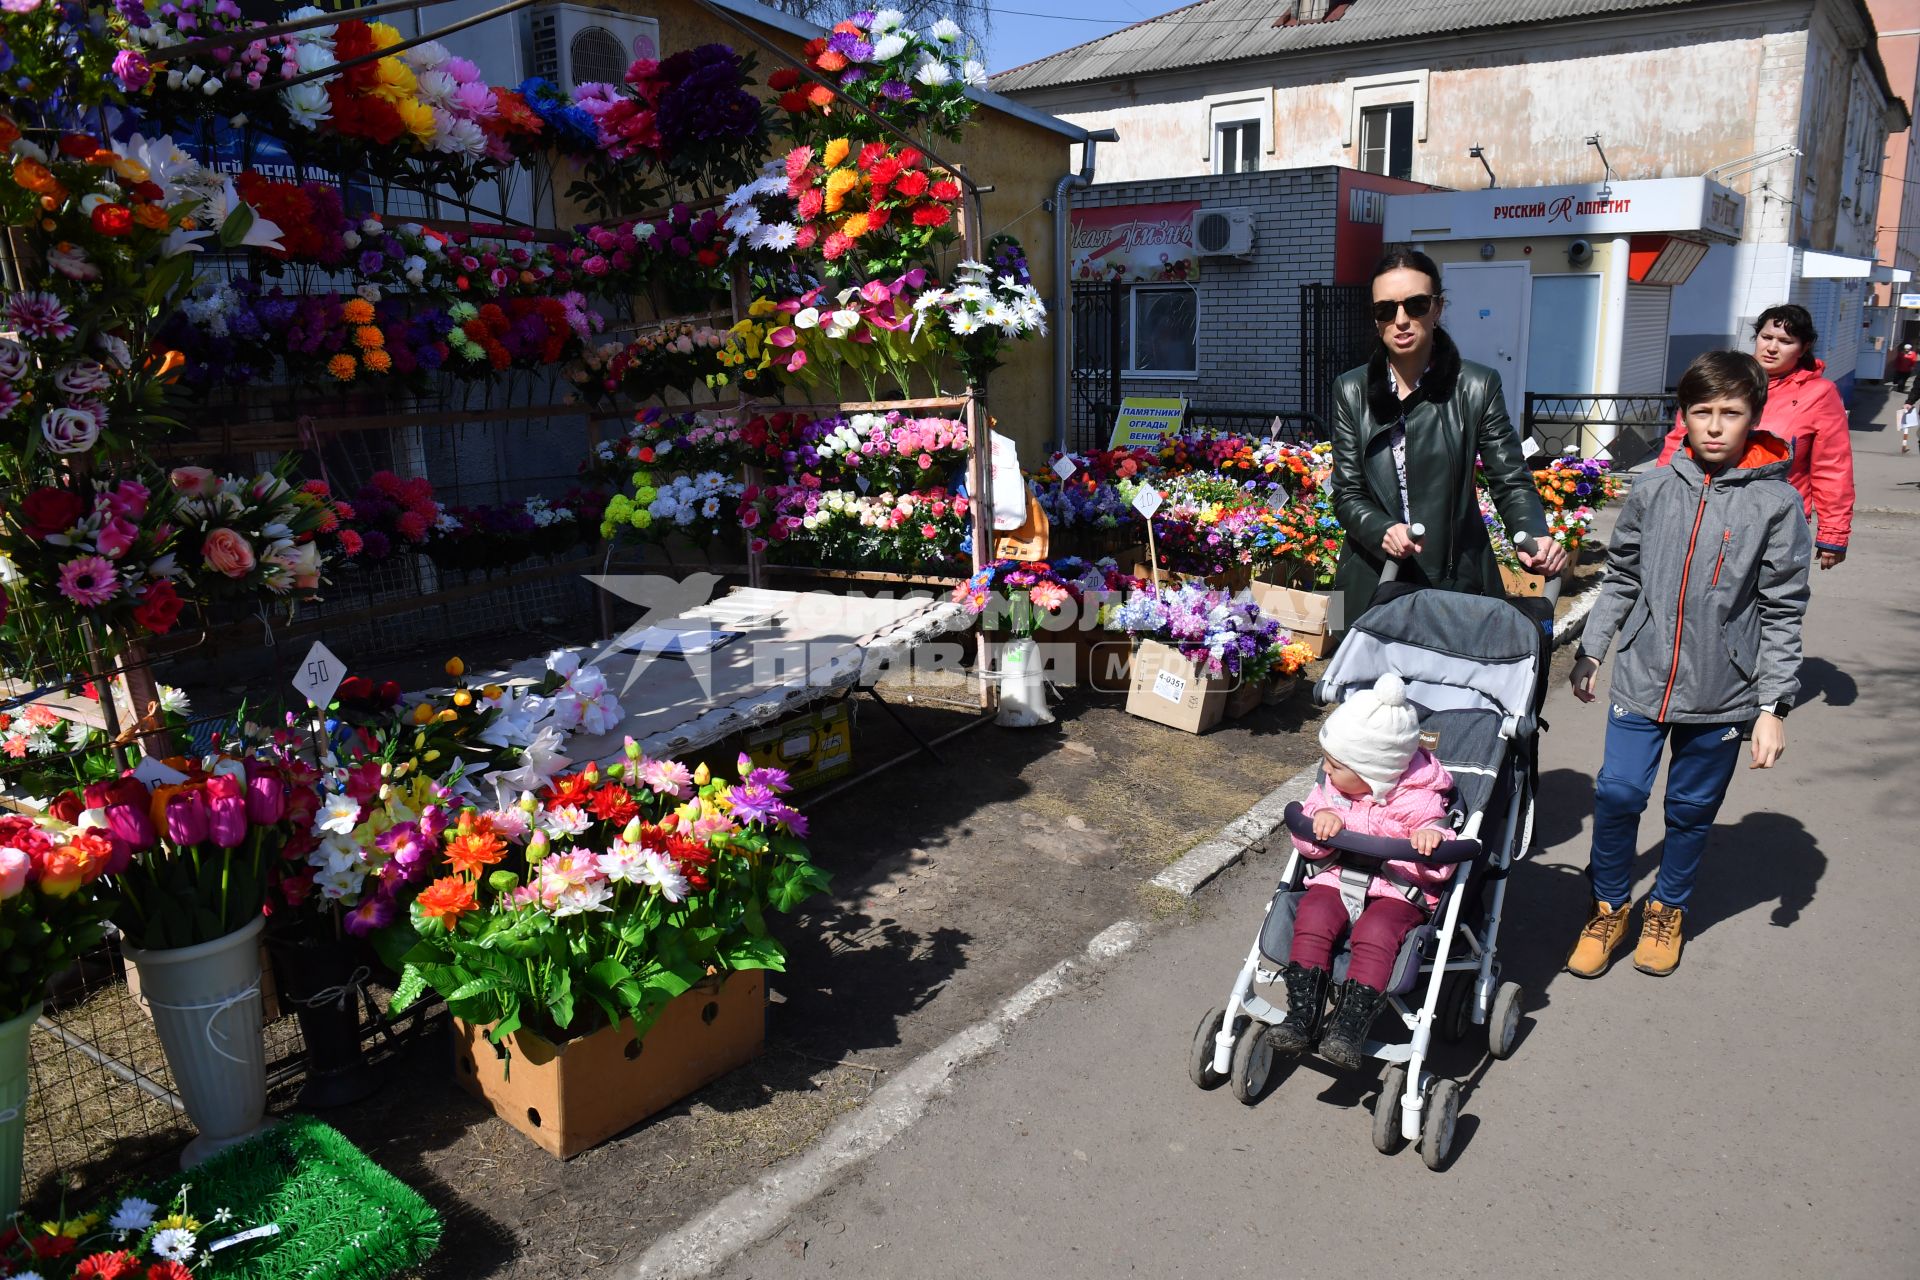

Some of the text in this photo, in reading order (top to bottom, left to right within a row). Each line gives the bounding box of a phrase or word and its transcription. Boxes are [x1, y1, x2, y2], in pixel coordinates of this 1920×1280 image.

[1494, 201, 1546, 219] РУССКИЙ
[1576, 199, 1631, 215] АППЕТИТ
[1123, 407, 1181, 417] ПАМЯТНИКИ
[1129, 420, 1168, 429] ОГРАДЫ
[1130, 432, 1160, 441] ВЕНКИ
[1087, 575, 1099, 587] 20
[307, 659, 330, 687] 50
[1159, 673, 1185, 690] 4-0351
